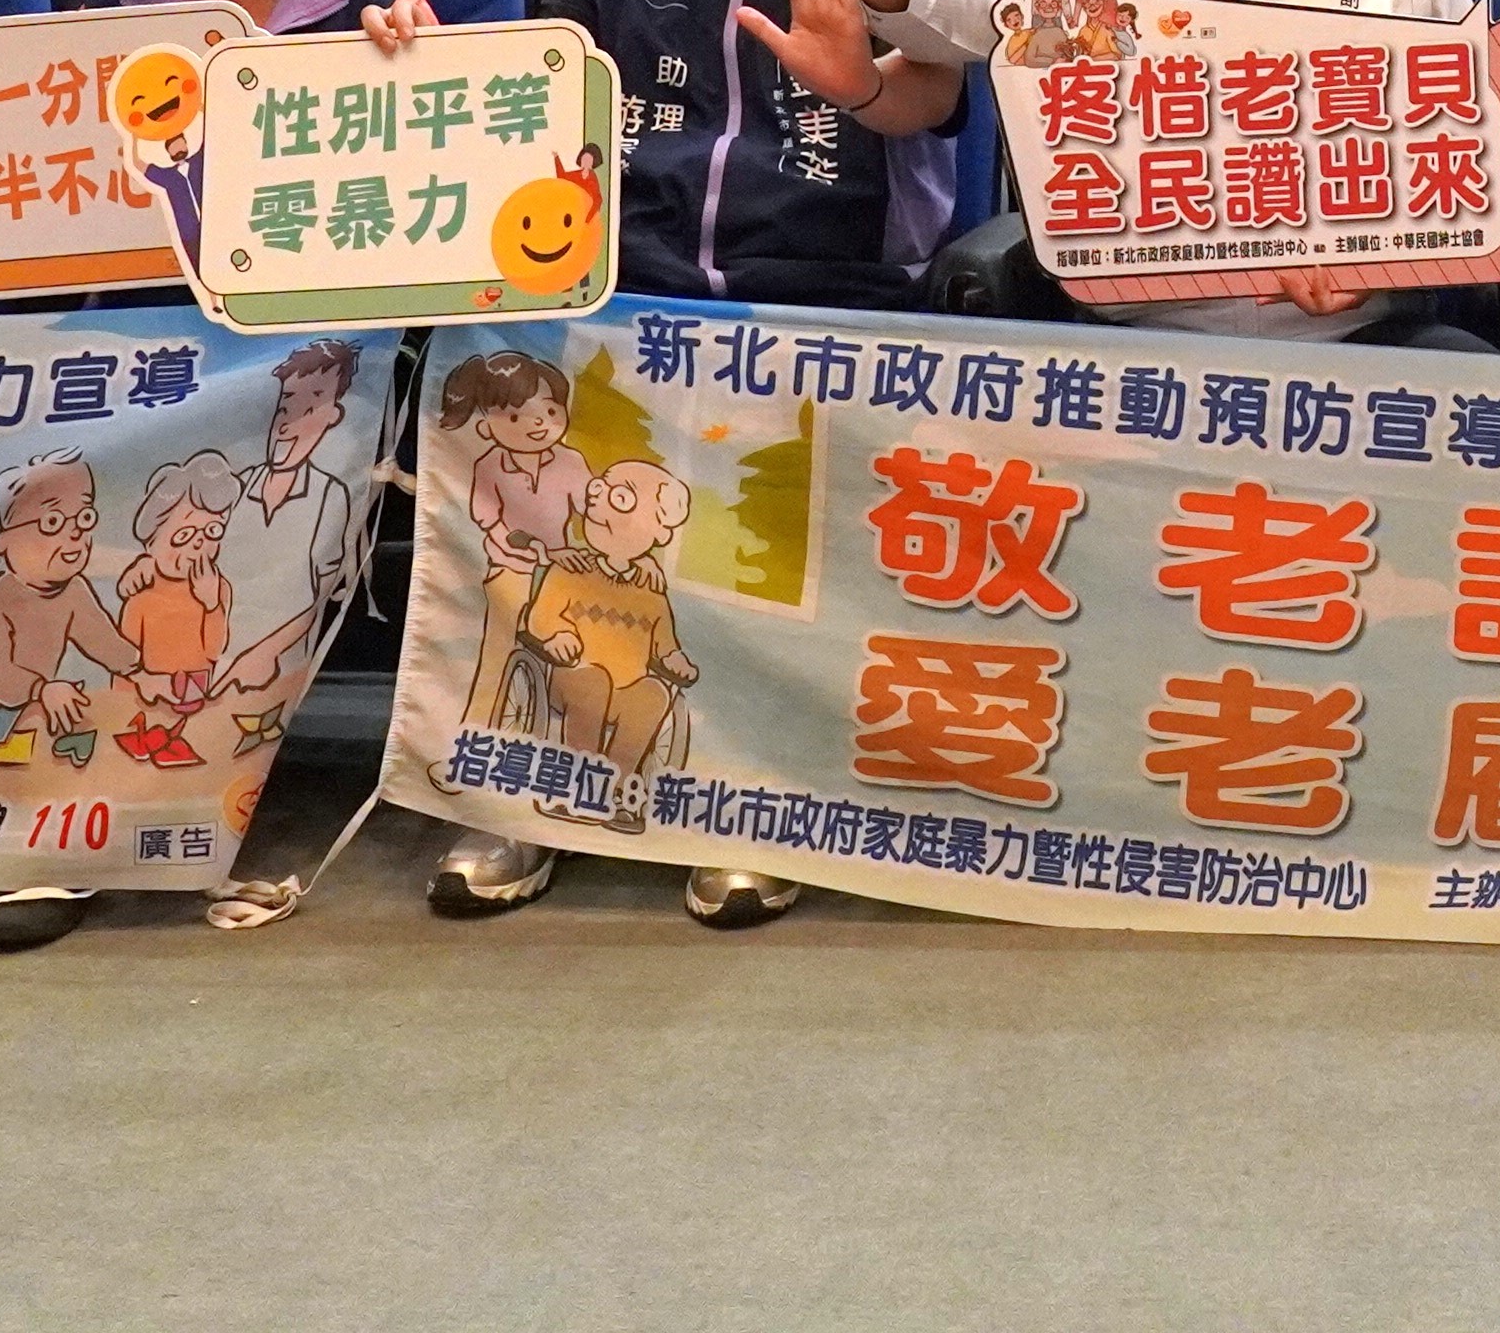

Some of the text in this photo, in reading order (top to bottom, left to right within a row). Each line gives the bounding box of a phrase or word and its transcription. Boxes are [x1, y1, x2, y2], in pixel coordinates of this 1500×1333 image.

[252, 73, 551, 160] 性別平等
[651, 55, 688, 133] 助理
[1040, 44, 1480, 145] 疼惜老寶貝
[248, 175, 468, 253] 零暴力
[1057, 229, 1484, 267] 指導單位：新北市政府家庭暴力暨性侵害防治中心 主辦單位：中華民國紳士協會
[27, 802, 110, 851] 110
[139, 827, 213, 861] 廣告
[446, 732, 1367, 910] 指導單位：新北市政府家庭暴力暨性侵害防治中心
